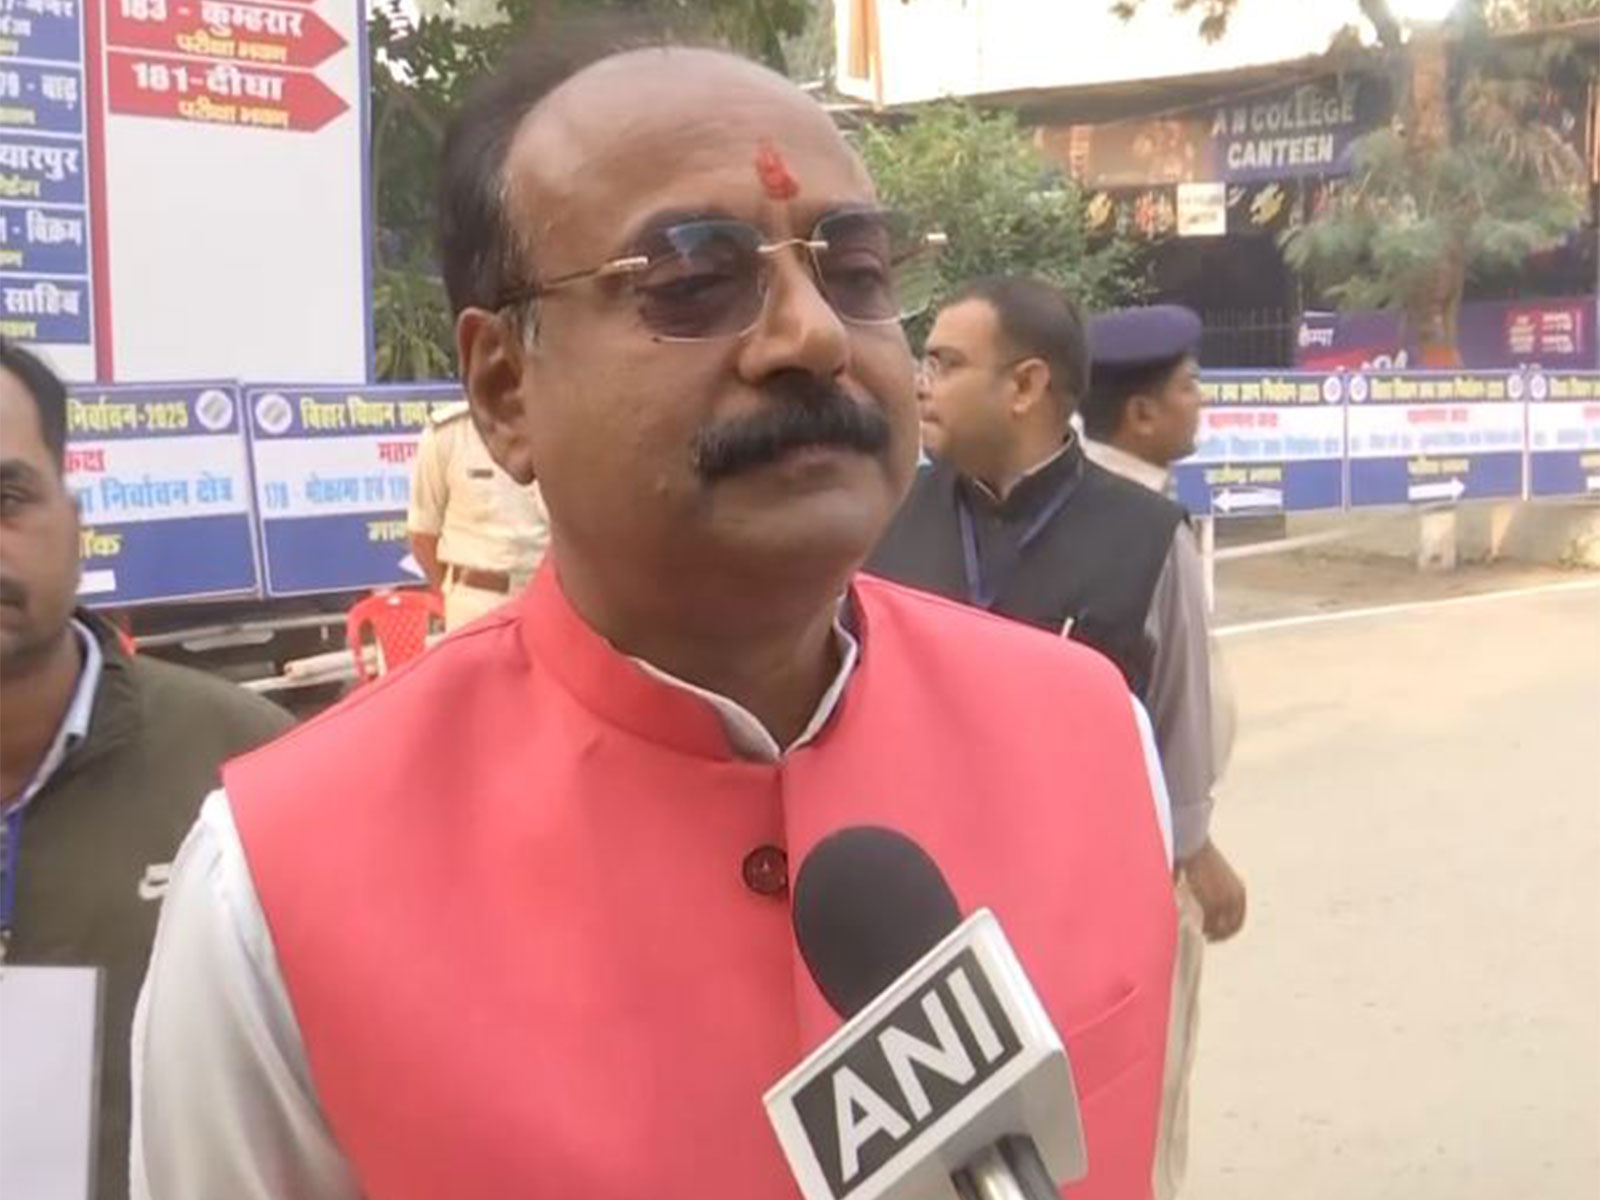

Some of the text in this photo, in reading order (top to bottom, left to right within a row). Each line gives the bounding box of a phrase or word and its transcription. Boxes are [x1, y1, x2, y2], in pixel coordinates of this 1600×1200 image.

[202, 3, 304, 37] कुम्हरार
[131, 62, 284, 101] 181-दीघा
[1210, 107, 1227, 138] A
[1250, 97, 1354, 133] COLLEGE
[0, 145, 79, 181] यारपुर
[1227, 133, 1334, 170] CANTEEN
[831, 965, 1005, 1183] ANI
